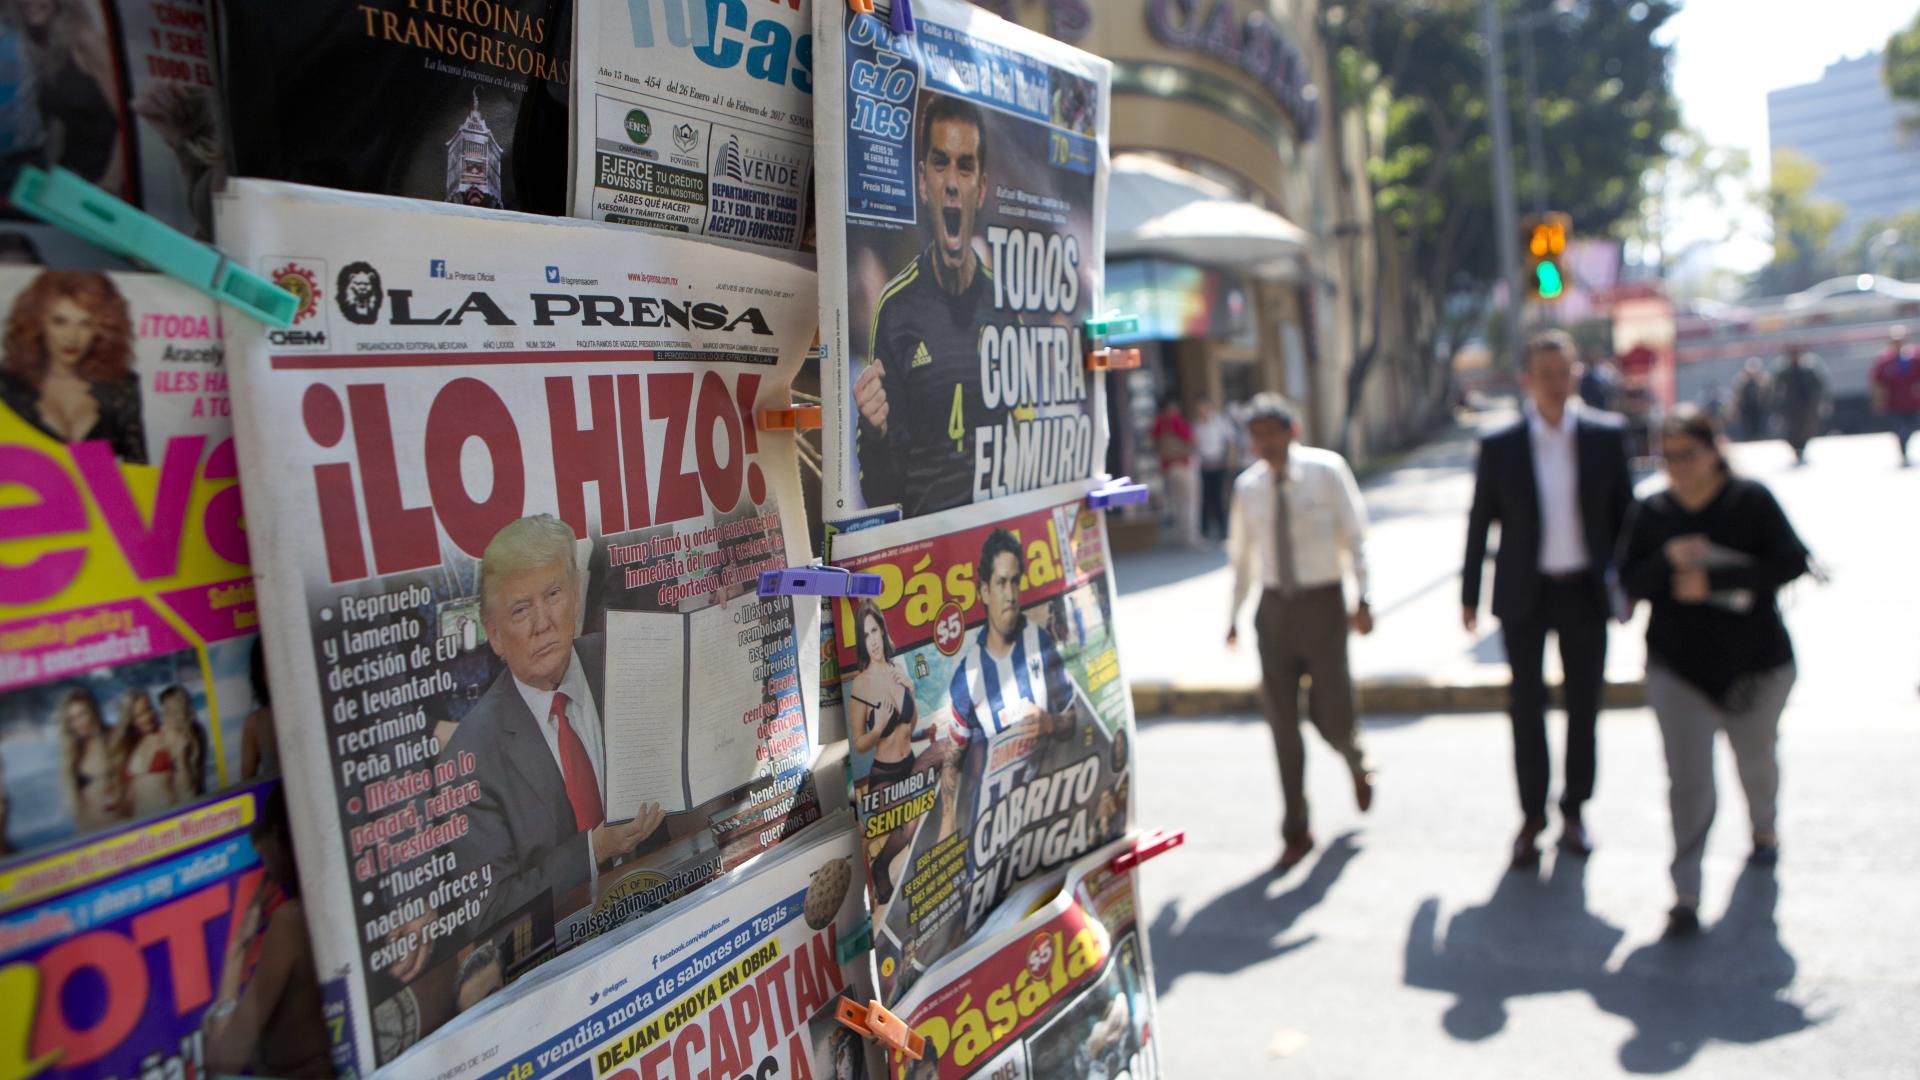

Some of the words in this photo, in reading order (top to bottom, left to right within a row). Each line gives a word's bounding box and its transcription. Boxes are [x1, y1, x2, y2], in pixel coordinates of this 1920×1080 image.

[358, 5, 569, 86] TRANSGRESORAS
[666, 79, 678, 94] del
[690, 87, 710, 103] Enero
[735, 99, 759, 116] Febrero
[770, 110, 785, 121] 2017
[601, 173, 653, 193] FOVISSSTE
[656, 185, 668, 195] CON
[671, 187, 704, 201] NOSOTROS
[602, 156, 653, 180] EJERCE
[656, 170, 667, 183] TU
[669, 173, 703, 190] CRÉDITO
[743, 158, 799, 187] VENDE
[598, 203, 628, 214] ASESORÍA
[635, 208, 665, 220] TRÁMITES
[666, 215, 699, 224] GRATUITOS
[613, 193, 643, 206] ¿SABES
[662, 201, 690, 213] HACER?
[712, 182, 770, 206] DEPARTAMENTOS
[712, 199, 726, 214] D.F.
[735, 204, 753, 218] EDO.
[755, 207, 765, 220] DE
[709, 215, 746, 235] ACEPTO
[747, 220, 795, 243] FOVISSSTE
[454, 273, 476, 281] Prensa
[716, 283, 737, 292] JUEVES
[755, 287, 772, 296] ENERO
[987, 226, 1079, 313] TODOS
[387, 289, 517, 326] LA
[530, 293, 774, 336] PRENSA
[980, 325, 1087, 409] CONTRA
[191, 396, 205, 416] A
[948, 383, 966, 452] 4
[302, 376, 525, 584] ¡LO
[545, 370, 767, 541] HIZO!
[973, 424, 1008, 503] EL
[1014, 414, 1091, 494] MURO
[608, 541, 649, 567] Trump
[651, 530, 682, 557] firmó
[683, 534, 692, 553] y
[693, 525, 723, 546] ordenó
[722, 512, 779, 540] construcción
[625, 559, 685, 590] inmediata
[686, 552, 702, 573] del
[703, 551, 726, 567] muro
[728, 548, 736, 563] y
[736, 536, 773, 558] acelerar
[774, 533, 783, 550] la
[341, 584, 431, 624] Repruebo
[658, 571, 722, 606] deportación
[723, 570, 734, 588] de
[738, 613, 792, 647] reembolsará,
[742, 602, 772, 625] México
[782, 596, 790, 609] lo
[936, 611, 961, 646] $5
[323, 637, 339, 665] y
[342, 616, 420, 655] lamento
[749, 638, 782, 663] aseguró
[784, 635, 793, 648] en
[328, 651, 407, 692] decisión
[410, 644, 431, 669] de
[436, 635, 458, 662] EU
[753, 653, 796, 682] entrevista
[332, 697, 358, 724] de
[362, 668, 458, 716] levantarlo,
[743, 700, 777, 724] centros
[777, 693, 800, 714] para
[337, 705, 427, 756] recriminó
[755, 745, 768, 762] de
[768, 731, 805, 757] ilegales
[757, 711, 803, 740] detención
[342, 753, 391, 788] Peña
[395, 735, 440, 769] Nieto
[365, 771, 433, 814] México
[434, 759, 457, 786] no
[458, 750, 476, 776] lo
[768, 750, 808, 777] También
[749, 769, 802, 807] beneficiará
[863, 792, 879, 812] TE
[884, 772, 924, 804] TUMBO
[927, 767, 935, 785] A
[351, 802, 423, 856] pagará,
[425, 780, 481, 821] reitera
[760, 814, 803, 848] queremos
[804, 807, 817, 822] un
[866, 789, 936, 838] SENTONES
[974, 755, 1100, 870] CABRITO
[355, 848, 377, 882] el
[378, 813, 469, 873] Presidente
[630, 878, 641, 889] OF
[966, 857, 1001, 930] EN
[1004, 809, 1089, 890] FUGA
[365, 896, 425, 942] nación
[429, 870, 479, 910] ofrece
[482, 863, 493, 888] y
[568, 908, 611, 942] Países
[611, 859, 713, 921] latinoamericanos
[715, 855, 724, 875] y
[370, 931, 417, 973] exige
[1028, 940, 1052, 971] $5
[537, 1022, 606, 1070] vendía
[607, 989, 653, 1030] mota
[655, 976, 675, 999] de
[677, 943, 732, 987] sabores
[734, 931, 751, 949] en
[752, 904, 787, 936] Tepis
[598, 1023, 660, 1074] DEJAN
[664, 988, 717, 1033] CHOYA
[720, 967, 739, 995] EN
[742, 941, 777, 978] OBRA
